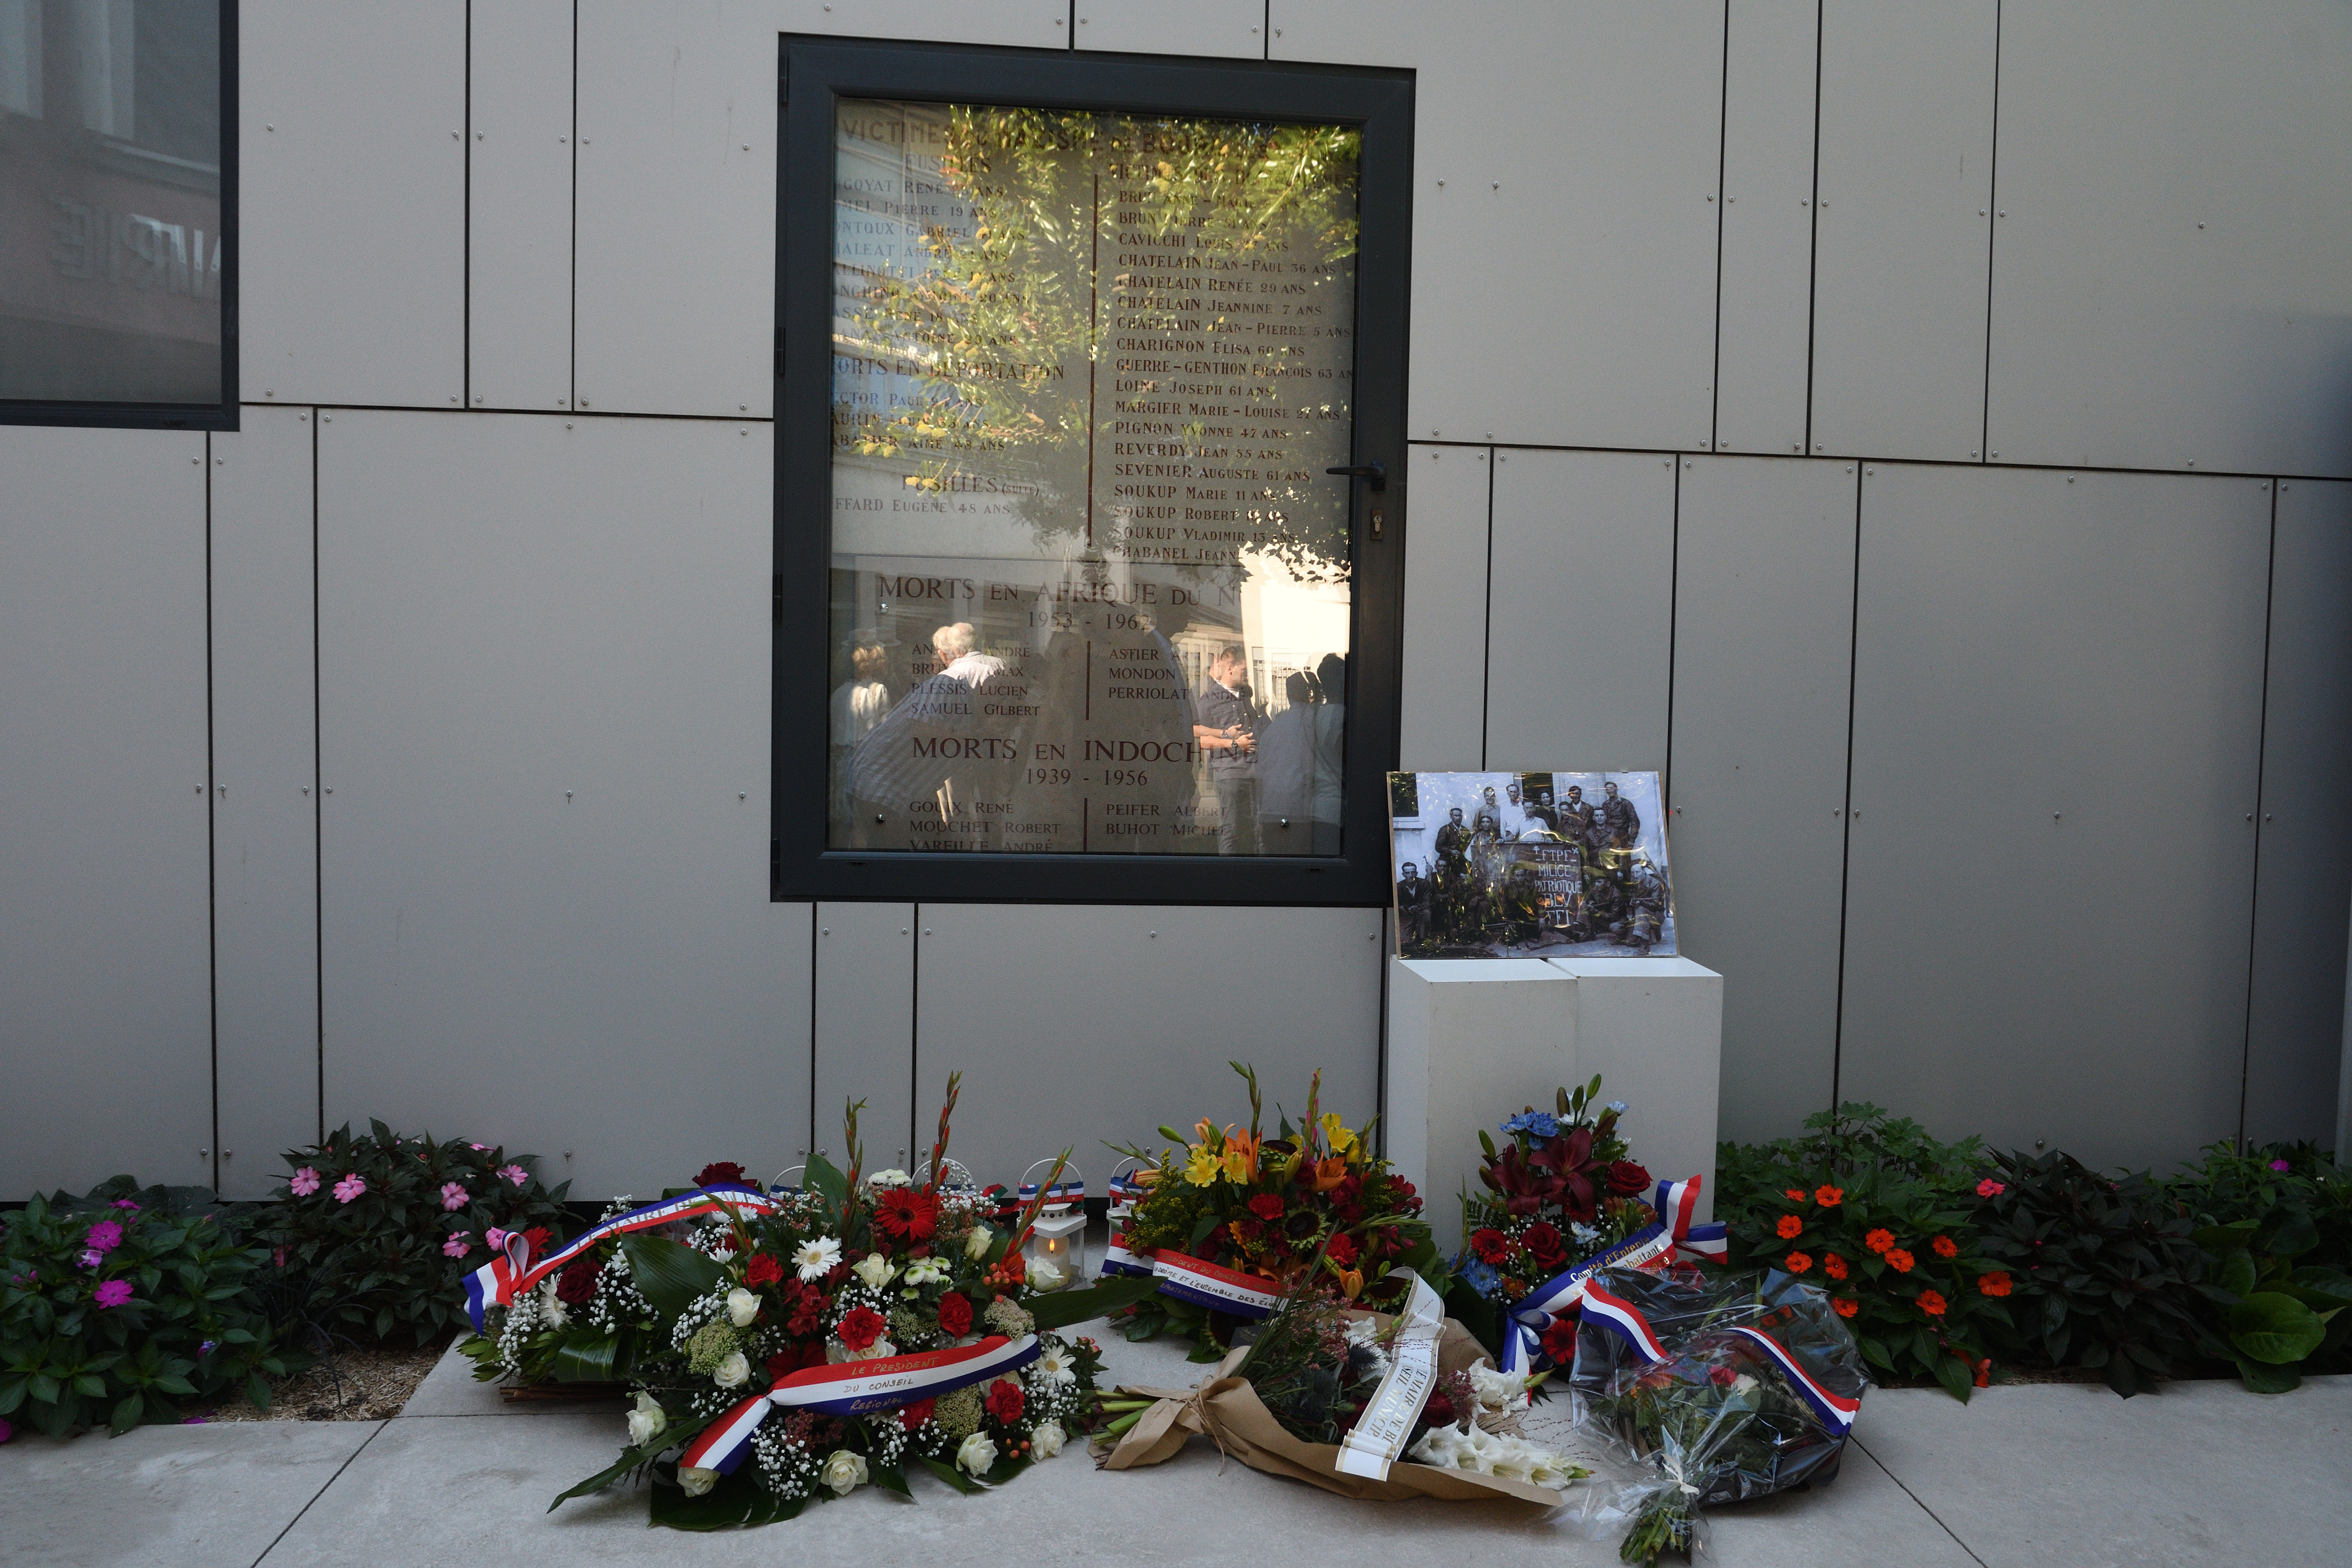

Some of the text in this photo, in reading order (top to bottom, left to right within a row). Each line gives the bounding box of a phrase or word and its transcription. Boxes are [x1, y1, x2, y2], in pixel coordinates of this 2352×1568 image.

[1109, 163, 1184, 181] VICTIMS
[904, 180, 943, 194] RENÉ
[885, 201, 997, 218] PIERRE 19 ANS
[1119, 212, 1156, 224] BRUN
[905, 224, 969, 239] GABRIEL
[1119, 233, 1186, 247] CAVICCHI
[1196, 235, 1233, 250] LOUIS
[1263, 241, 1288, 251] ANS
[981, 250, 1007, 261] ANS
[1119, 254, 1201, 269] CHATELAIN
[1291, 263, 1306, 274] 36
[1312, 265, 1336, 275] ANS
[989, 272, 1015, 282] ANS
[1118, 276, 1306, 294] CHATELAIN RENÉE 29 ANS
[980, 293, 996, 303] 20
[1118, 296, 1322, 316] CHATELAIN JEANNINE 7 ANS
[930, 313, 943, 323] 18
[1117, 317, 1200, 332] CHATELAIN
[1313, 327, 1320, 336] 5
[1326, 327, 1351, 338] ANS
[1116, 338, 1305, 357] CHARIGNON ELISA 60 ANS
[833, 357, 888, 375] ORTS
[896, 359, 919, 376] EN
[1116, 359, 1247, 375] GUERRE-GENTHON
[1253, 364, 1312, 380] FRANÇOIS
[1318, 369, 1332, 379] 63
[1169, 382, 1222, 396] JOSEPH
[1229, 387, 1241, 397] 61
[1247, 387, 1273, 397] ANS
[889, 393, 922, 406] PAUL
[1115, 401, 1181, 415] MARGIER
[1316, 410, 1340, 420] ANS
[1115, 422, 1287, 439] PIGNON YVONNE 47 ANS
[954, 440, 972, 450] 48
[979, 441, 1005, 451] ANS
[1115, 443, 1283, 460] REVERDY JEAN 55 ANS
[1114, 463, 1310, 482] SEVENIER AUGUSTE 61 ANS
[902, 473, 1039, 496] FUSILLÉS (SUITE)
[1114, 485, 1277, 502] SOUKUP MARIE 11 ANS
[893, 498, 947, 513] EUGÈNE
[958, 504, 976, 514] 48
[984, 504, 1010, 514] ANS
[1113, 506, 1238, 521] SOUKUP ROBERT
[1113, 527, 1295, 543] SOUKUP VLADIMIR 13 ANS
[1113, 546, 1243, 561] CHABANEL JEANN
[879, 576, 975, 600] MORTS
[990, 584, 1018, 601] EN
[1034, 581, 1157, 607] AFRIQUE
[1171, 589, 1200, 606] DU
[1029, 611, 1150, 630] 1953 1962
[984, 642, 1031, 658] ANDRÉ
[1109, 648, 1159, 662] ASTIER
[1109, 668, 1175, 681] MONDON
[912, 682, 1028, 697] PLESSIS LUCIEN
[1108, 687, 1246, 702] PERRIOLAT ANDRÉ
[911, 702, 1040, 716] SAMUEL GILBERT
[912, 737, 1259, 764] MORTS EN INDOCHINE
[1027, 768, 1148, 787] 1939 1956
[975, 799, 1014, 814] RENÉ
[1106, 804, 1228, 817] PEIFER ALBERT
[910, 821, 1061, 834] MOUCHET ROBERT
[1106, 824, 1227, 836] BUHOT MICHEL
[1003, 839, 1053, 851] ANDRÉ
[1541, 849, 1571, 862] FTPF
[1538, 862, 1571, 877] MILICE
[1534, 878, 1583, 894] PATRIOTIQUE
[1545, 909, 1571, 926] FFI
[576, 1189, 767, 1250] LE MAIRE ALEN
[1570, 1236, 1650, 1282] Comité d'Entente
[1200, 1266, 1212, 1274] DU
[1214, 1269, 1249, 1285] CONSEIL
[1160, 1282, 1220, 1307] EPARTEMENTAUX
[1189, 1279, 1234, 1298] L'ENSEMBLE
[1237, 1294, 1255, 1304] DES
[852, 1356, 940, 1376] LE PRESIDENT
[843, 1375, 914, 1394] DU CONSEIL
[849, 1396, 904, 1412] REGIONAL
[1366, 1363, 1414, 1438] SEIL MUNICIP
[1389, 1375, 1425, 1432] MAIRE DE
